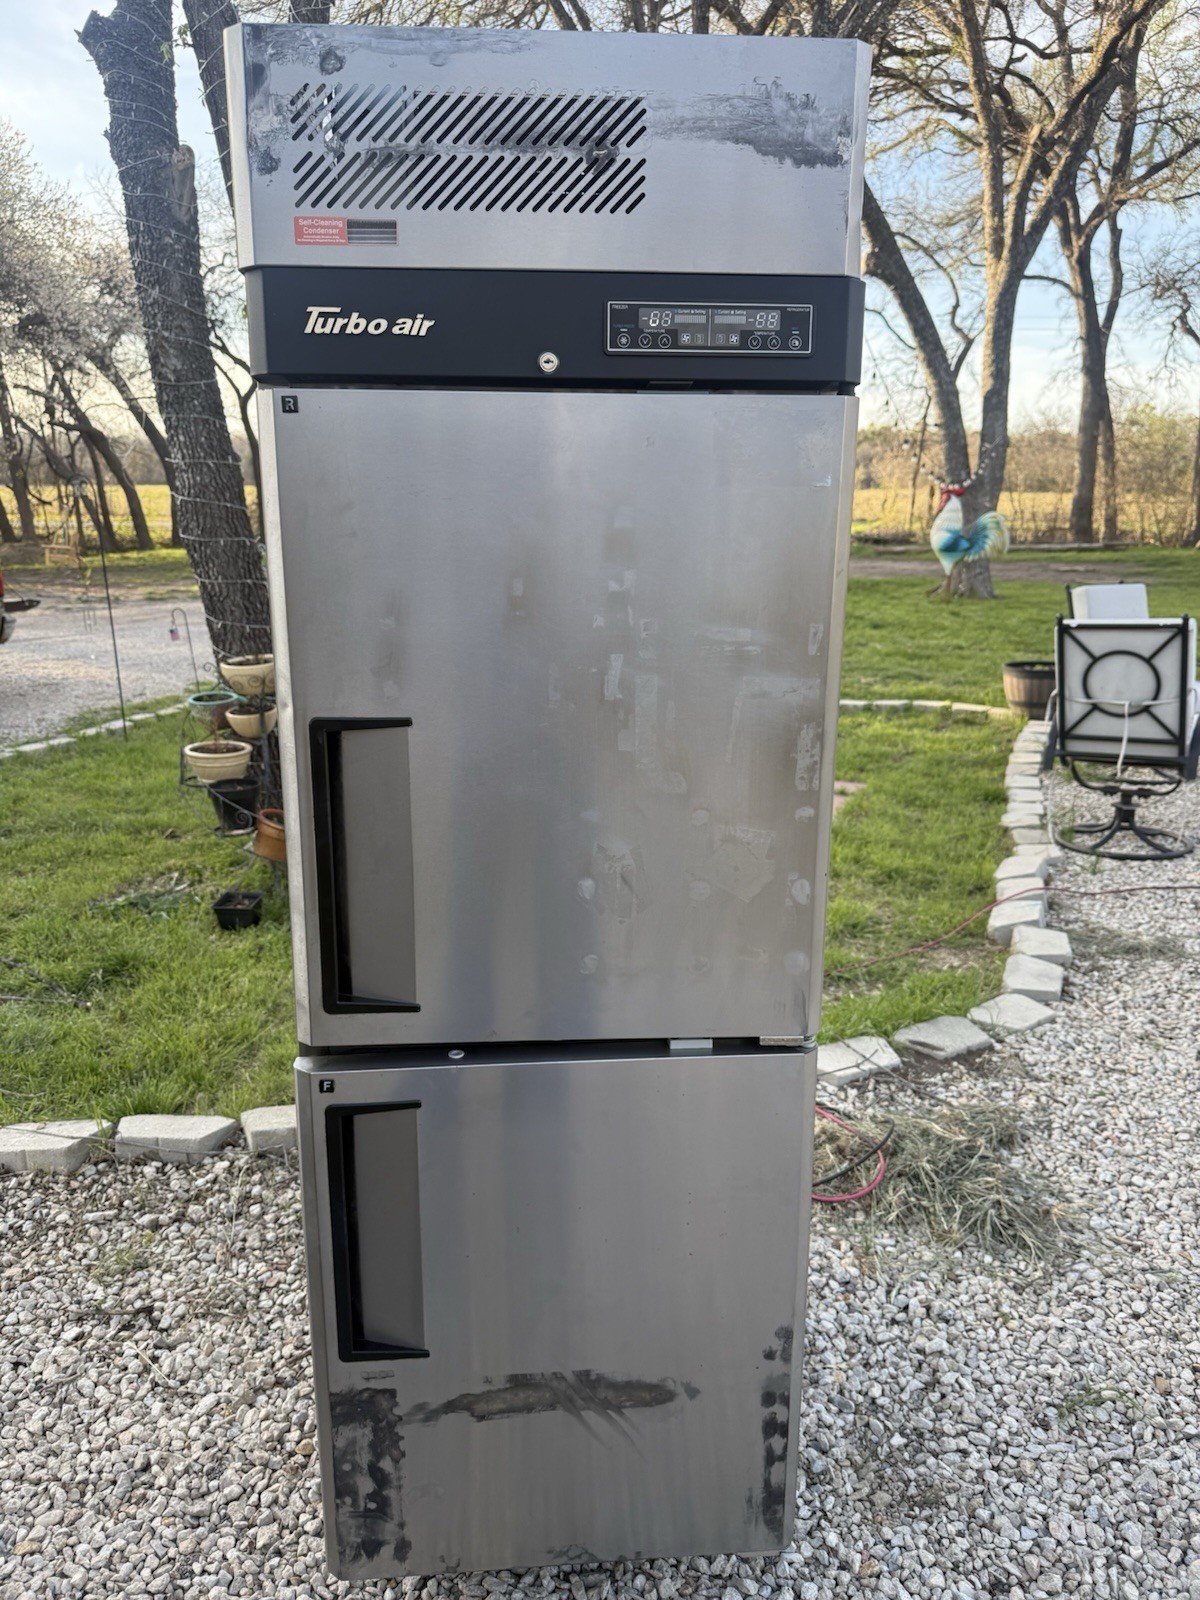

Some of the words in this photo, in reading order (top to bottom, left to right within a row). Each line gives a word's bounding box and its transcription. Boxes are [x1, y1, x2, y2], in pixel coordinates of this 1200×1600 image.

[298, 218, 343, 228] Self-Cleaning
[303, 226, 339, 234] Condenser
[304, 306, 388, 335] Turbo
[392, 314, 435, 336] air
[285, 398, 295, 410] R
[323, 1081, 331, 1091] F
